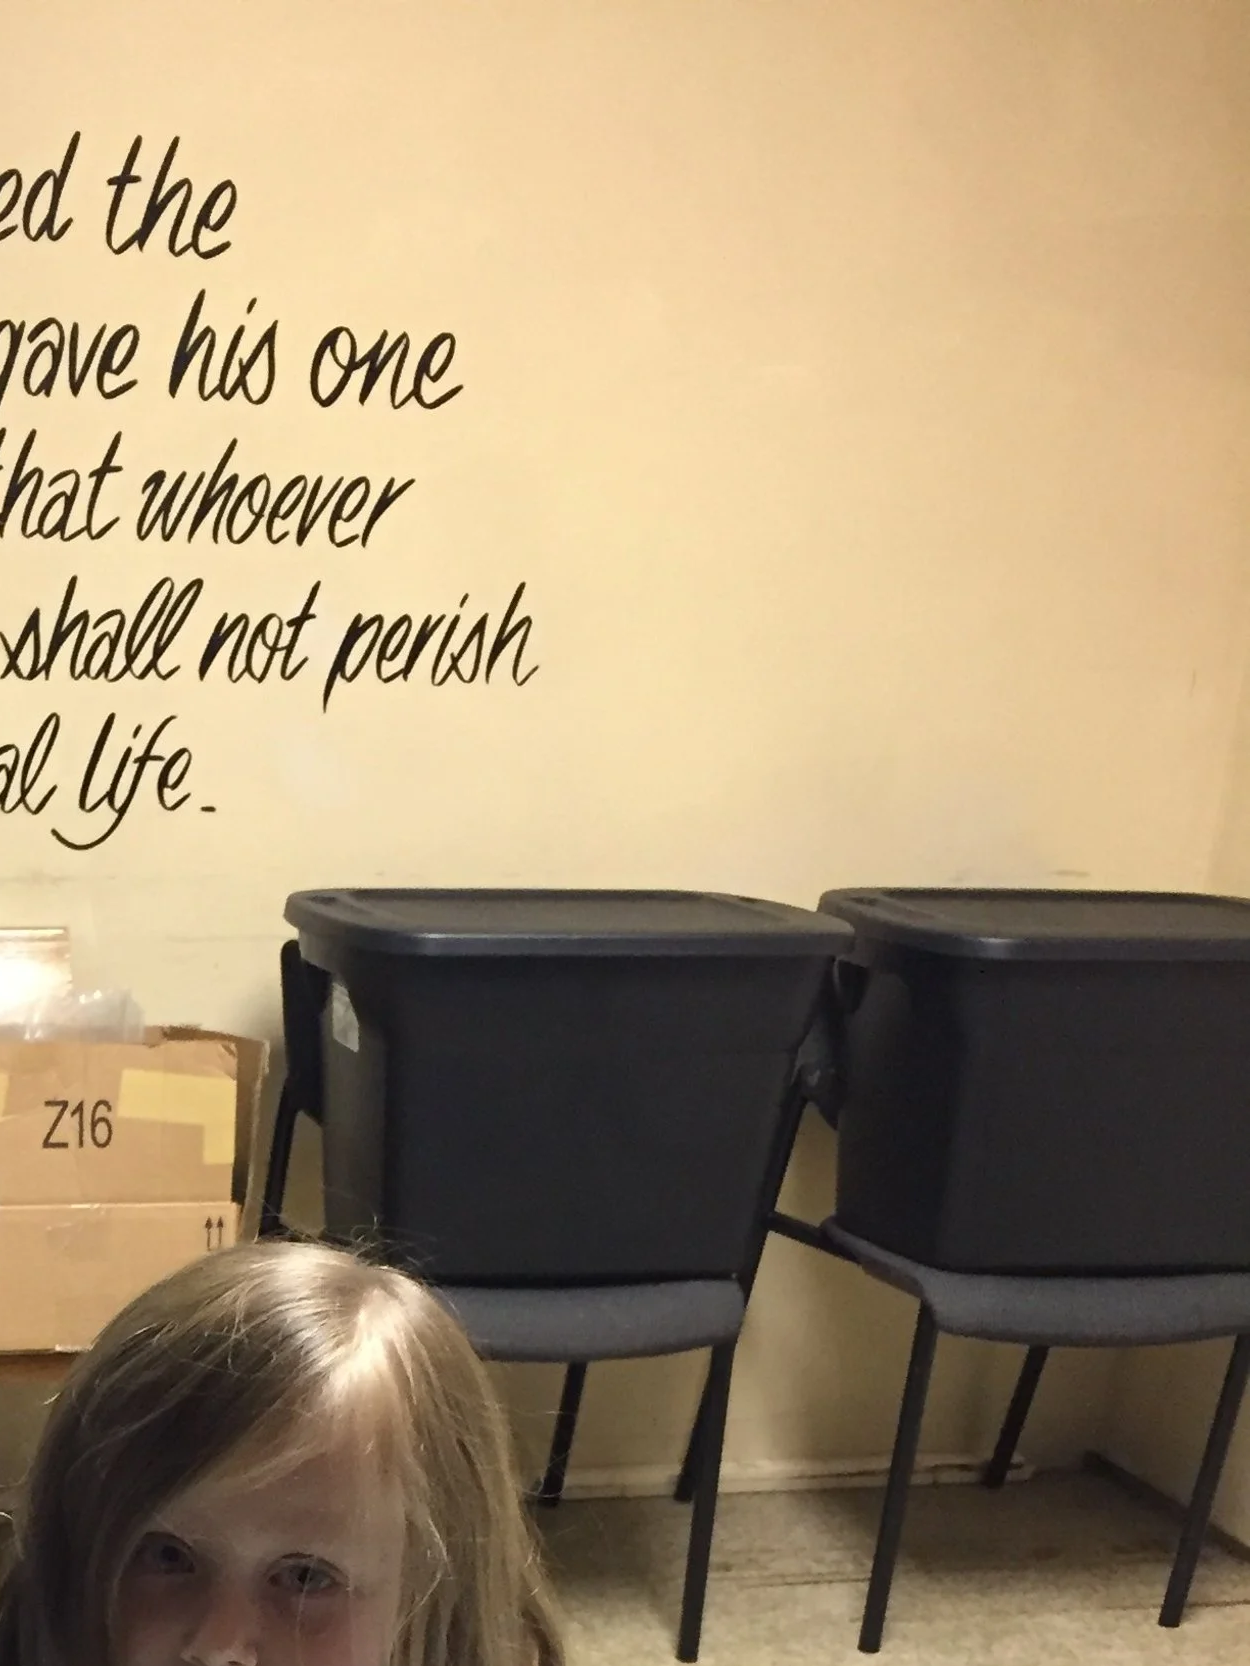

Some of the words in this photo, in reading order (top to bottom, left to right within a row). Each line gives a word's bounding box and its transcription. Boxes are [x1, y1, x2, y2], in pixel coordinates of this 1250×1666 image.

[105, 135, 238, 260] the
[168, 288, 280, 406] his
[310, 326, 464, 411] one
[136, 438, 416, 549] whoever
[0, 574, 204, 683] shall
[198, 580, 321, 684] not
[323, 580, 540, 714] perish
[41, 1098, 114, 1149] Z16
